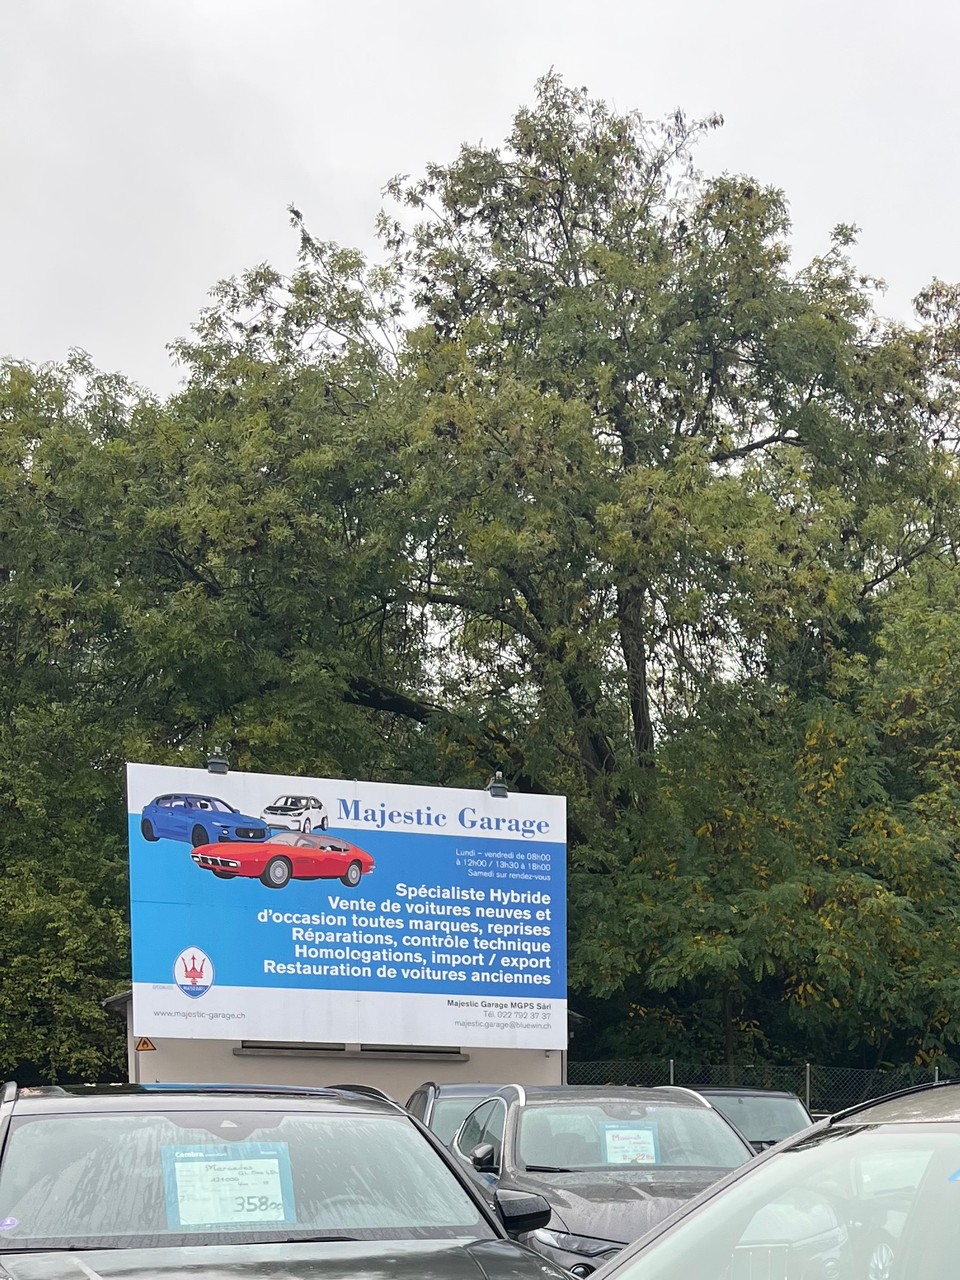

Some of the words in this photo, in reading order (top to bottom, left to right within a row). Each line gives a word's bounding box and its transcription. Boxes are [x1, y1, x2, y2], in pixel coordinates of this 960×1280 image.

[337, 798, 447, 828] Majestic
[458, 807, 550, 838] Garage
[456, 848, 476, 856] Lundi
[484, 851, 514, 859] vendredi
[516, 852, 525, 860] de
[526, 852, 551, 861] 08h00
[456, 858, 461, 866] à
[464, 859, 487, 867] 12h00
[496, 861, 519, 869] 13h30
[528, 863, 551, 871] 18h00
[468, 869, 495, 877] Samedi
[509, 873, 551, 881] rendez-vous
[395, 883, 485, 902] Spécialiste
[490, 888, 551, 906] Hybride
[328, 895, 376, 912] Vente
[380, 899, 401, 913] de
[406, 900, 470, 918] voitures
[476, 906, 532, 919] neuves
[536, 907, 551, 921] et
[352, 914, 404, 930] toutes
[409, 919, 483, 935] marques,
[487, 923, 551, 940] reprises
[292, 928, 398, 948] Réparations,
[402, 934, 469, 949] contrôle
[473, 937, 551, 954] technique
[295, 945, 427, 965] Homologations,
[431, 950, 484, 969] import
[488, 953, 497, 966] /
[501, 956, 551, 972] export
[264, 960, 371, 977] Restauration
[376, 964, 397, 978] de
[402, 965, 467, 981] voitures
[471, 969, 551, 985] anciennes
[447, 1000, 479, 1008] Majestic
[481, 1001, 508, 1009] Garage
[154, 1010, 246, 1020] www.majestic-garage.ch
[484, 1010, 496, 1018] Tél.
[530, 1012, 539, 1020] 37
[542, 1012, 551, 1020] 37
[454, 1019, 552, 1030] majestic.garage@bluewin.ch
